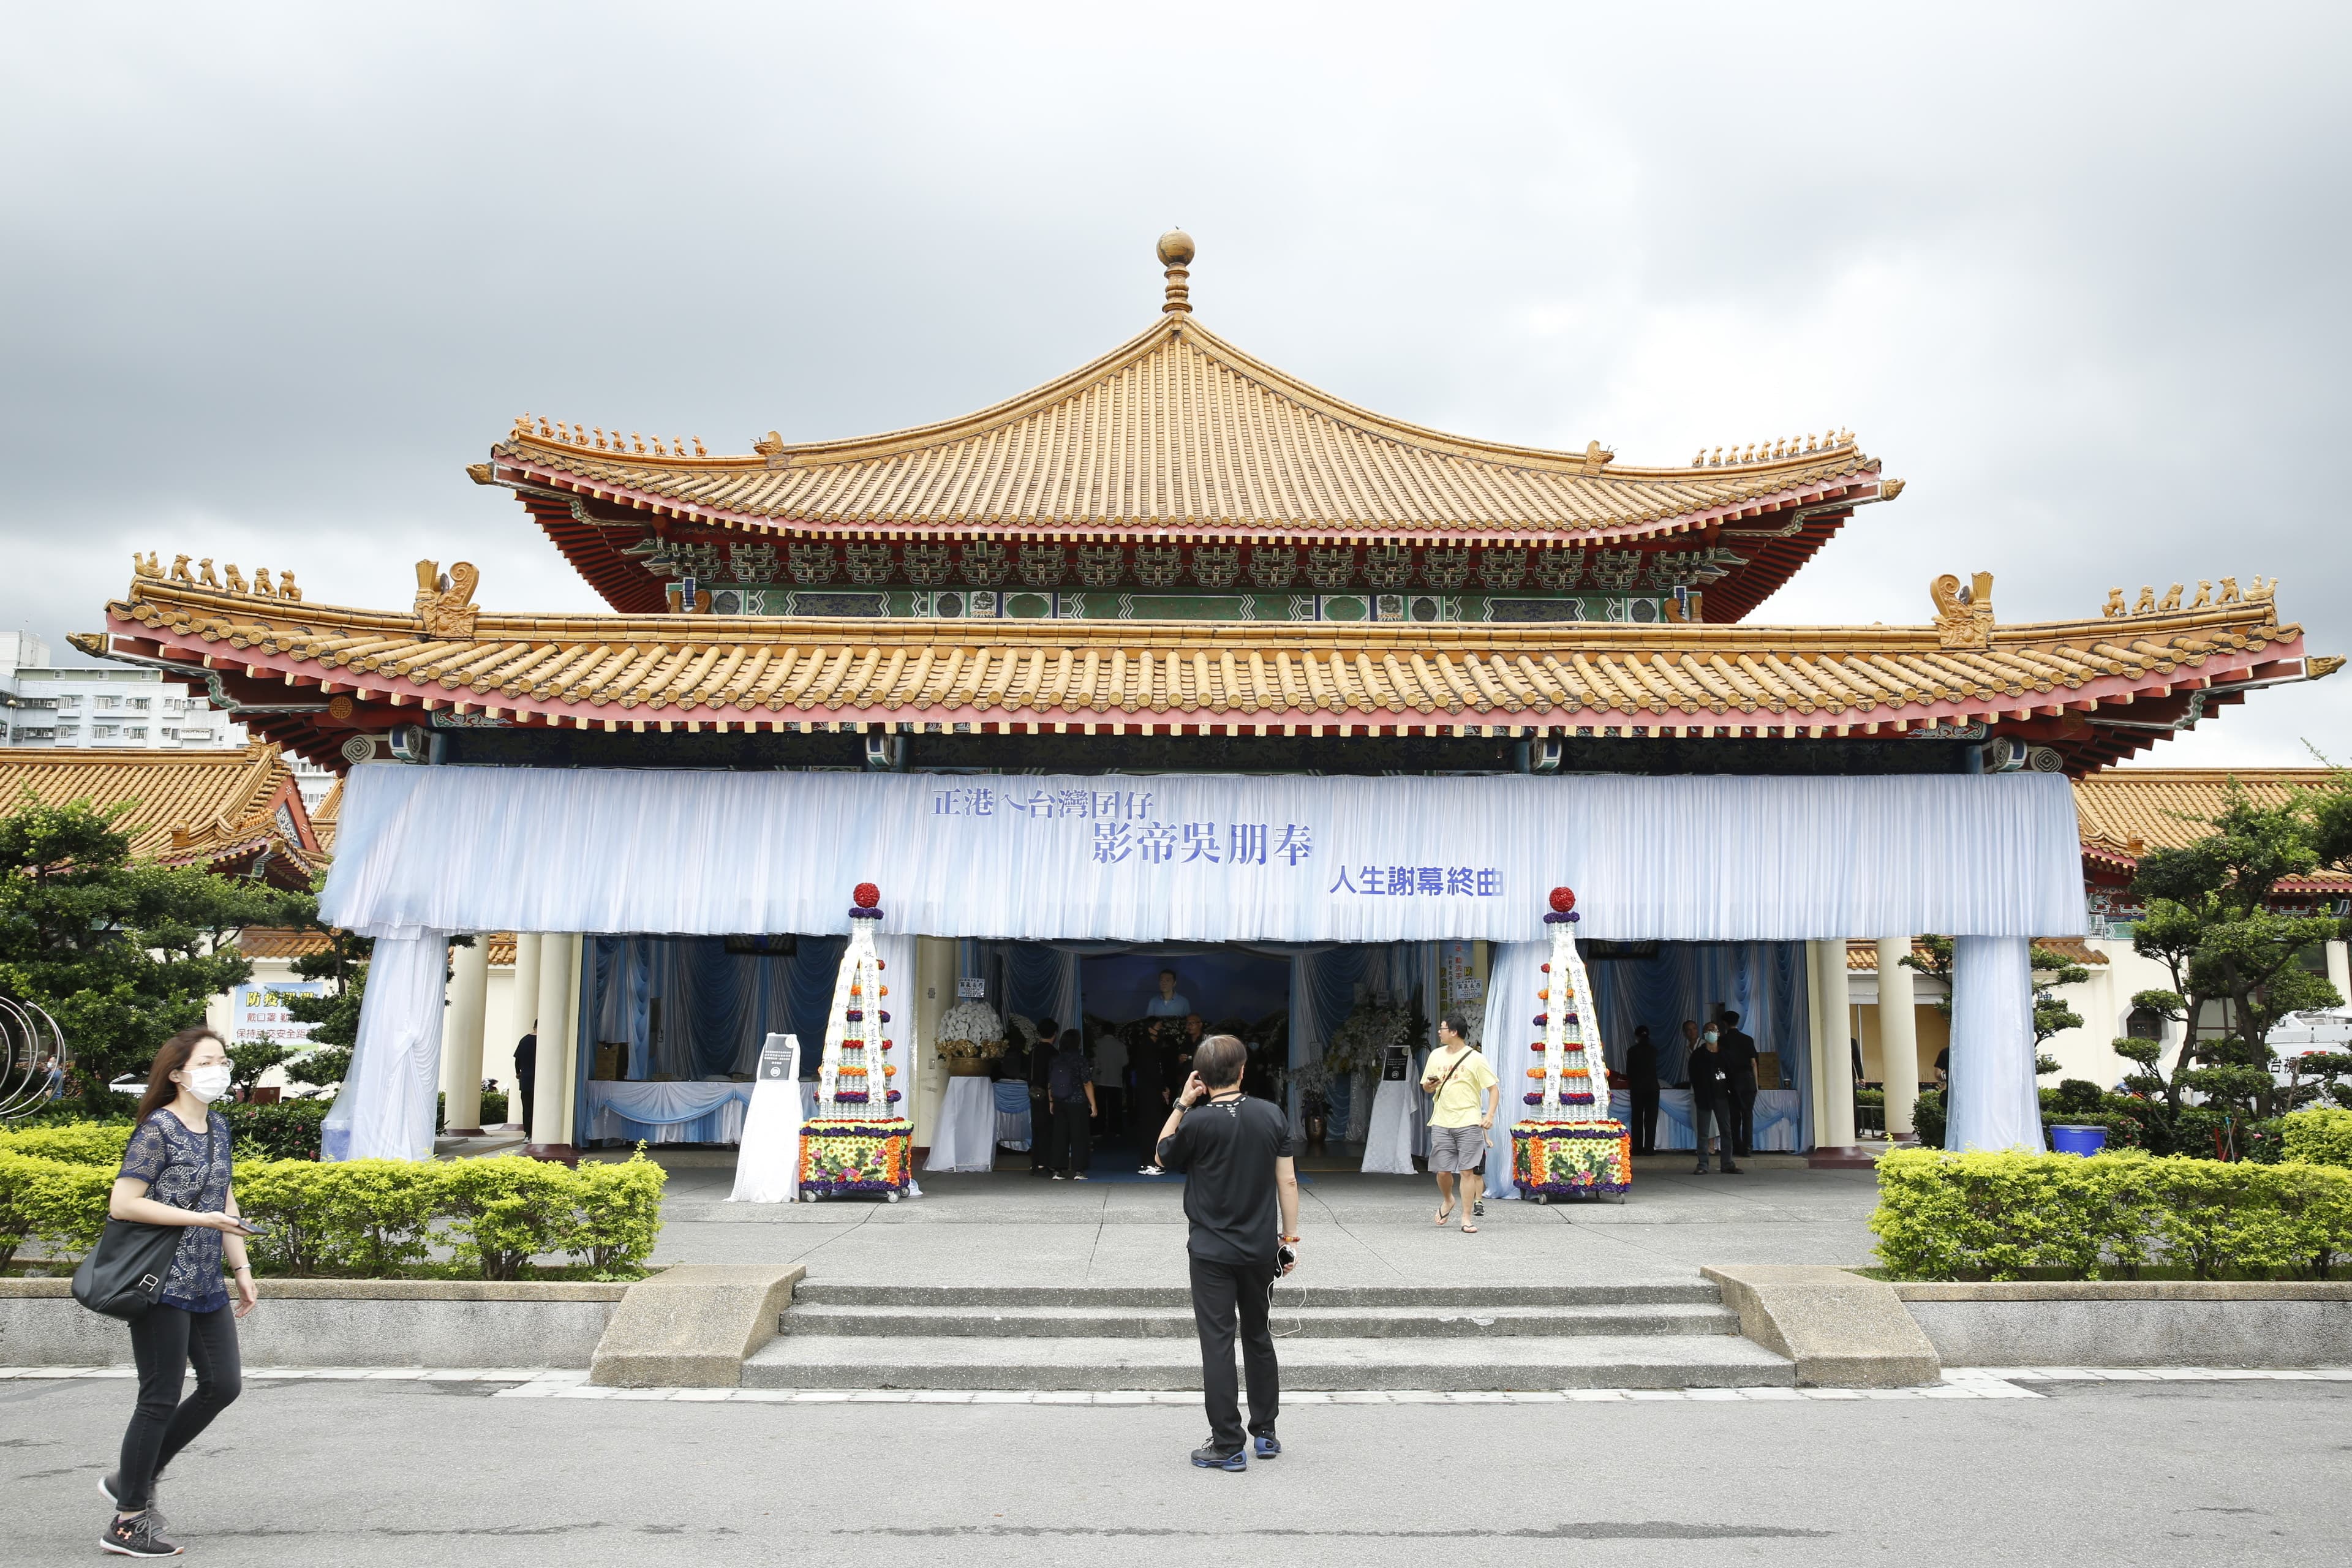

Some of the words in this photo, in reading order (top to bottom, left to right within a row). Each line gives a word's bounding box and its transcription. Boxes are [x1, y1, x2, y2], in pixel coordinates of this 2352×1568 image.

[1091, 821, 1314, 867] 影帝吳朋奉
[1329, 865, 1504, 897] 人生謝幕終曲
[247, 1012, 276, 1022] 戴口罩
[236, 1028, 312, 1039] 保持社交安全距
